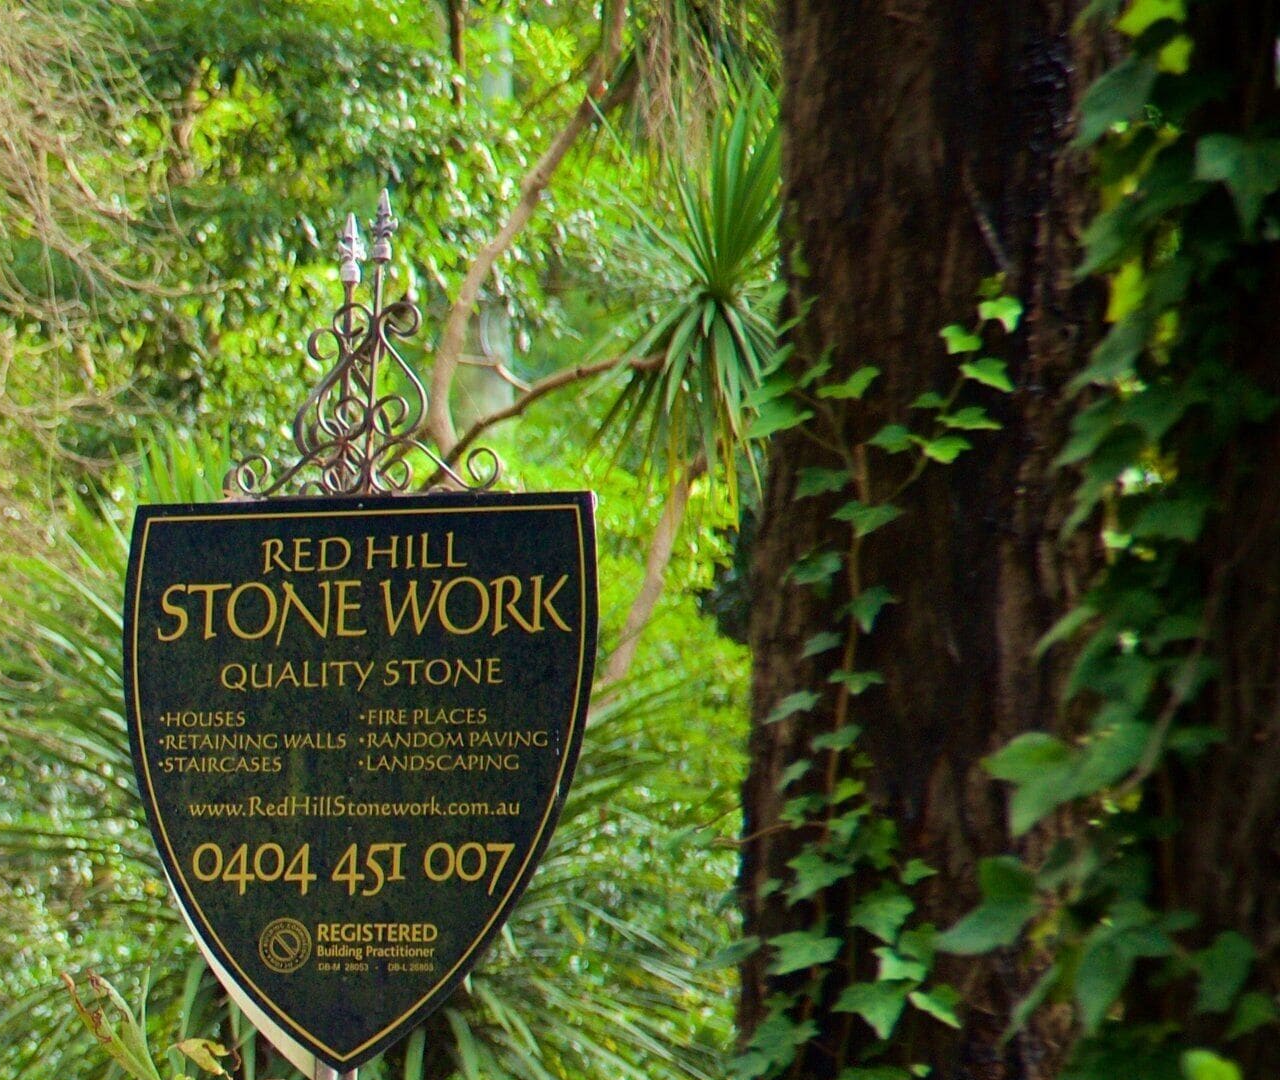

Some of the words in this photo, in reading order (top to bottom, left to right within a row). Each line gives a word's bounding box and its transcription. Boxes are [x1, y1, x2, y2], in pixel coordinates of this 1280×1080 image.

[261, 537, 352, 574] RED
[366, 531, 467, 570] HILL
[156, 580, 367, 646] STONE
[379, 574, 572, 637] WORK
[220, 660, 375, 692] QUALITY
[383, 658, 503, 687] STONE
[166, 711, 246, 727] HOUSES
[367, 709, 407, 725] FIRE
[412, 708, 487, 725] PLACES
[165, 733, 278, 751] RETAINING
[283, 732, 347, 749] WALLS
[365, 732, 464, 749] RANDOM
[469, 730, 548, 748] PAVING
[163, 756, 282, 773] STAIRCASES
[366, 754, 519, 772] LANDSCAPING
[188, 795, 520, 817] www.RedHillStonework.com.au
[191, 842, 317, 896] 0404
[331, 842, 407, 897] 451
[423, 842, 516, 896] 007
[317, 923, 438, 942] REGISTERED
[317, 944, 363, 961] Building
[365, 945, 435, 958] Practitioner
